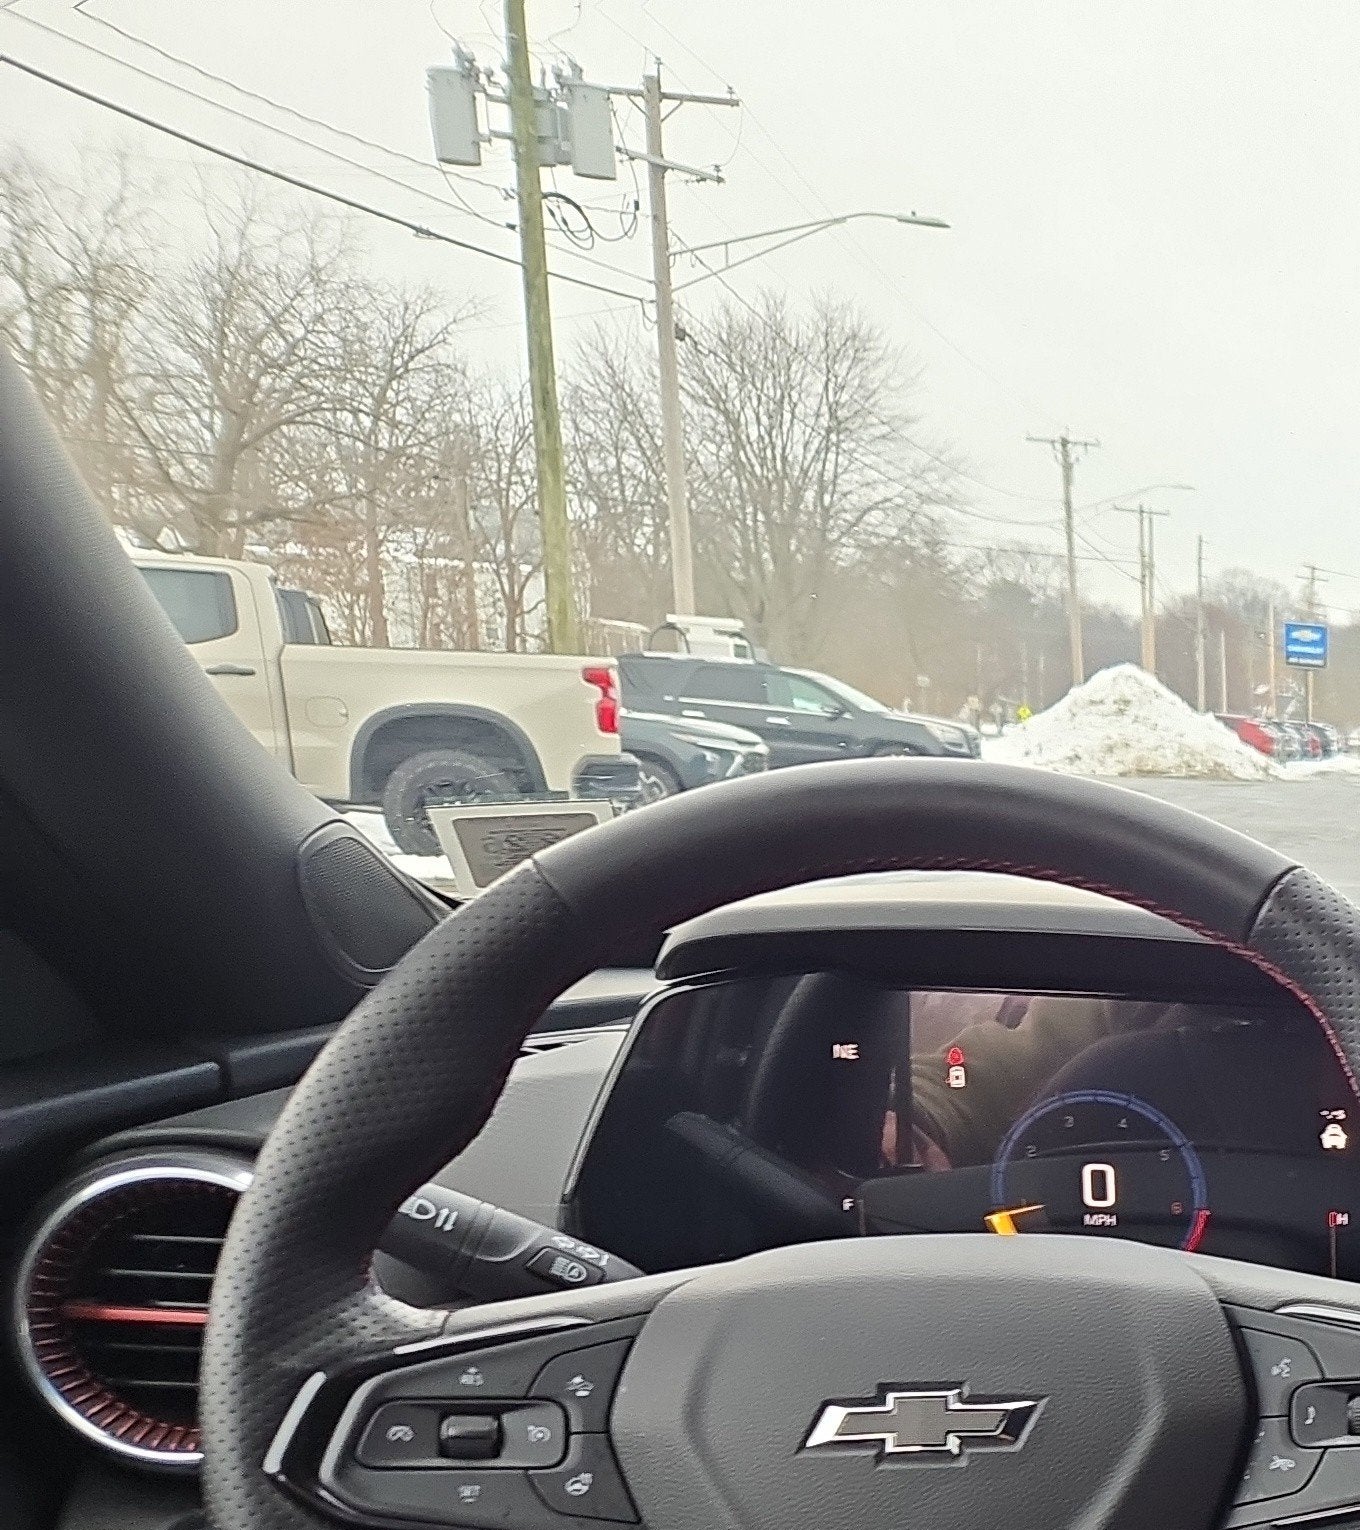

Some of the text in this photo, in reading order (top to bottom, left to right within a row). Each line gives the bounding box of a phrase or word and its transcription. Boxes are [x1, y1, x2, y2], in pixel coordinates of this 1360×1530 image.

[1081, 1163, 1116, 1208] 0
[842, 1199, 855, 1211] F
[1083, 1213, 1118, 1227] MPH
